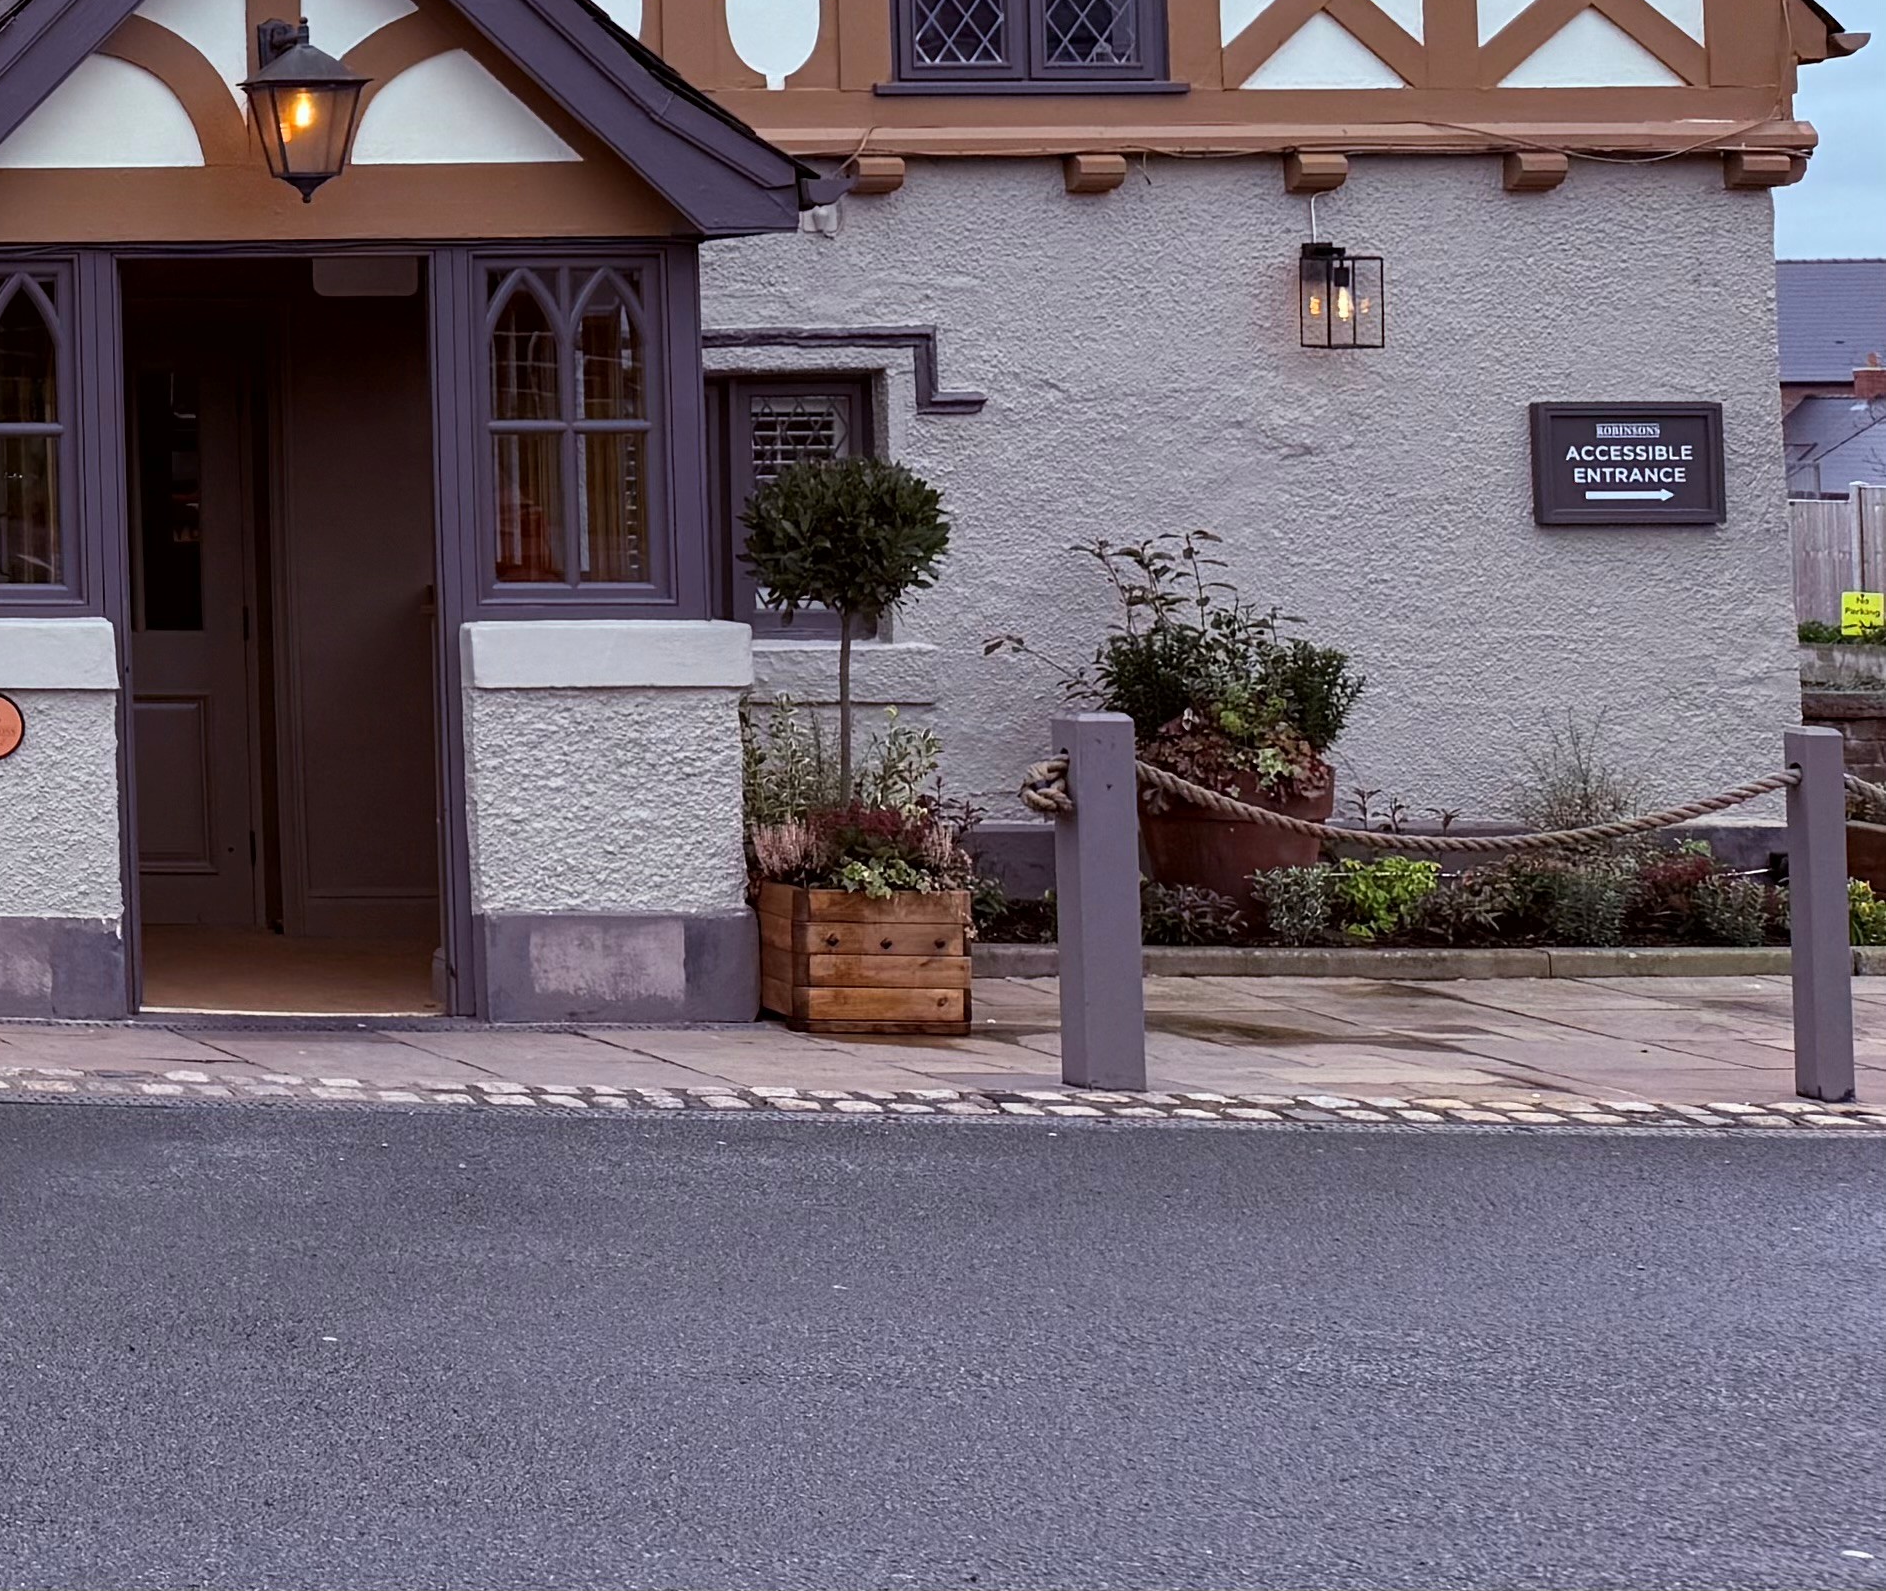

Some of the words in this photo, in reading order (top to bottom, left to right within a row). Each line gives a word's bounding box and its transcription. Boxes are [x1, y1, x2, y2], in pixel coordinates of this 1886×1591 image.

[1597, 424, 1660, 437] ROBINSONS
[1565, 445, 1694, 461] ACCESSIBLE
[1573, 467, 1687, 483] ENTRANCE
[1844, 607, 1881, 618] Parking
